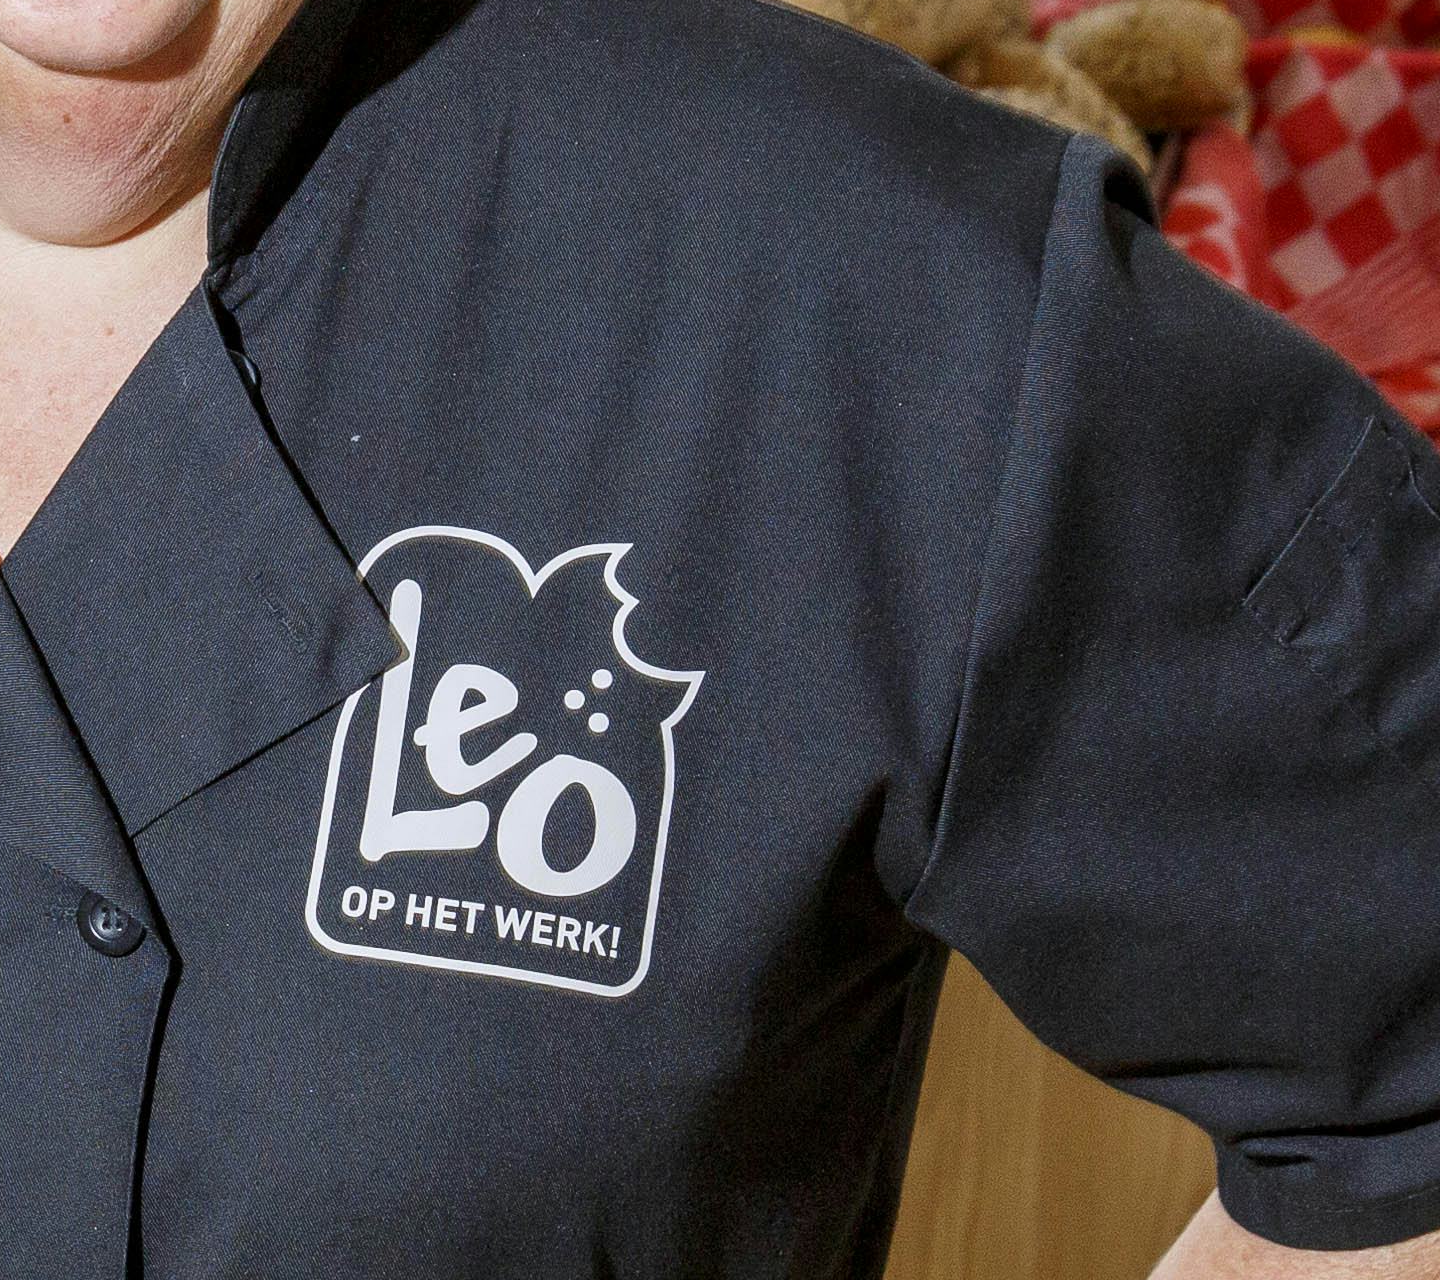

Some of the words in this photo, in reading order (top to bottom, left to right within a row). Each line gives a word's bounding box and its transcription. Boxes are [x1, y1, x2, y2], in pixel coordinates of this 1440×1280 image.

[359, 578, 637, 897] Leo
[341, 885, 395, 921] OP
[405, 893, 485, 936] HET
[494, 904, 622, 960] WERK!
